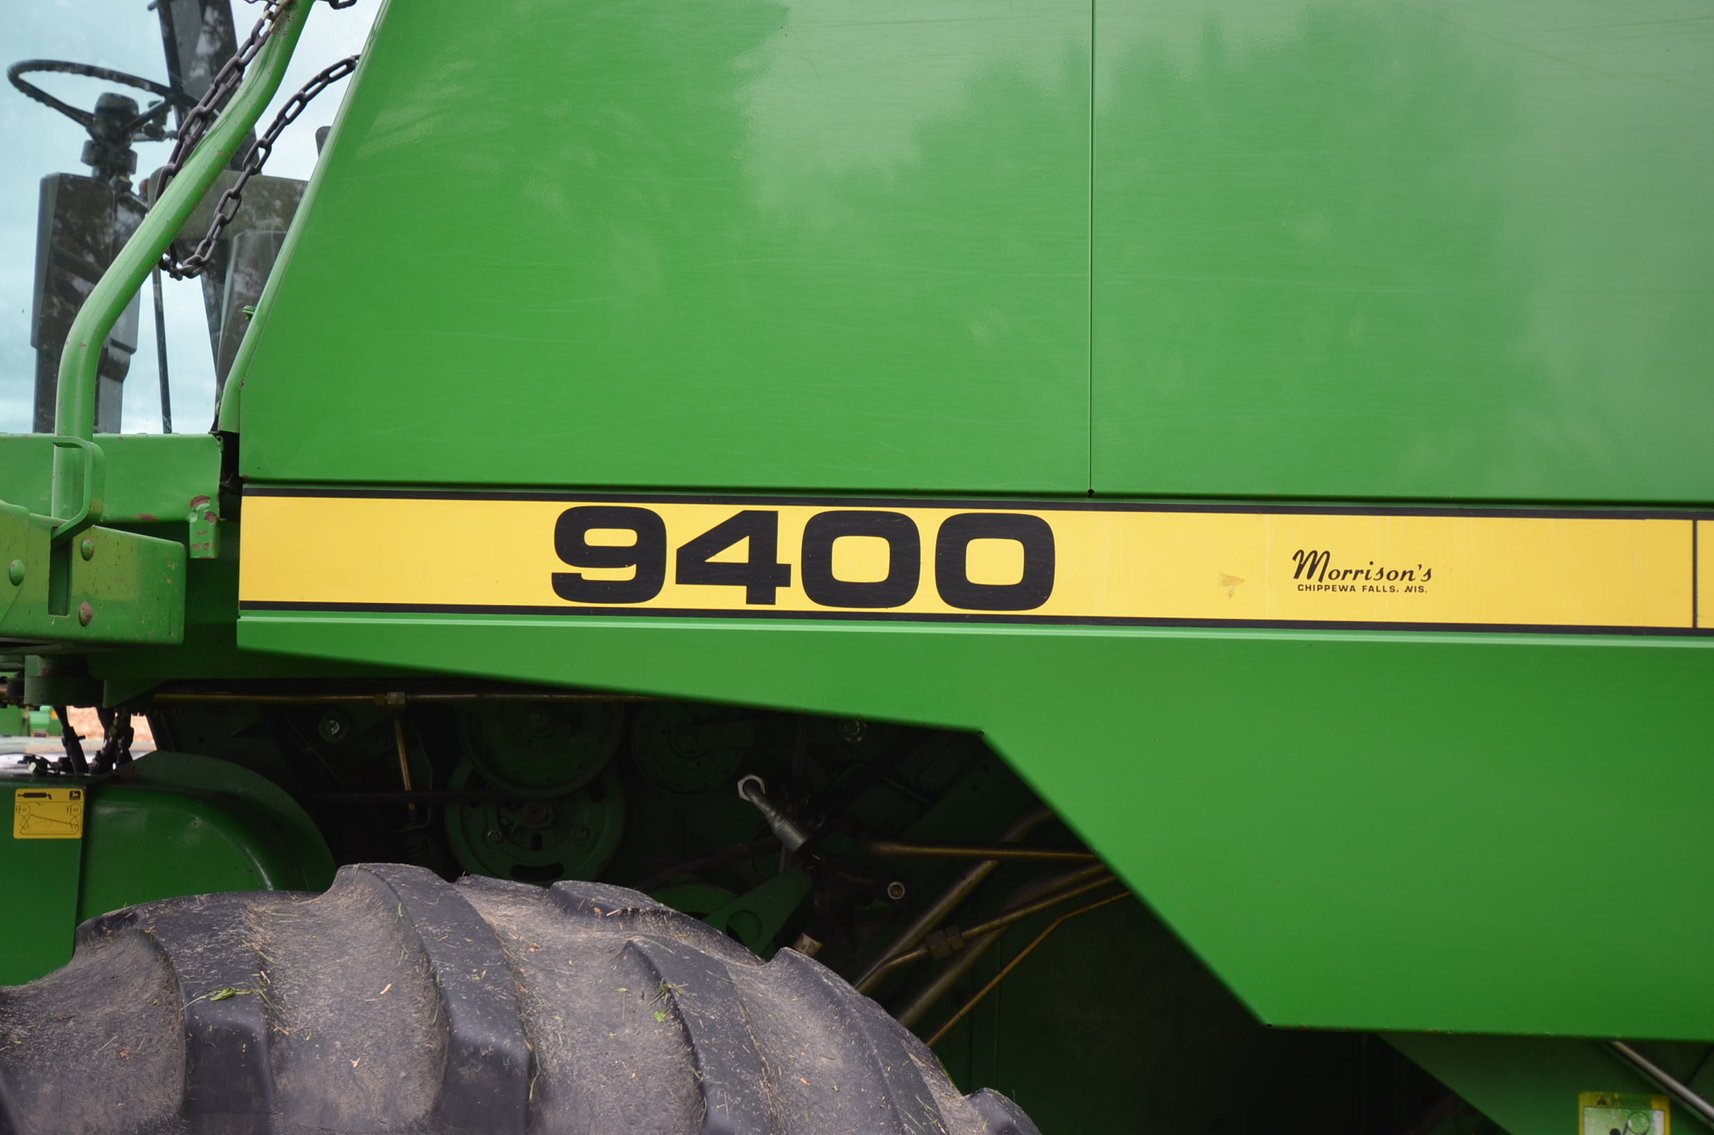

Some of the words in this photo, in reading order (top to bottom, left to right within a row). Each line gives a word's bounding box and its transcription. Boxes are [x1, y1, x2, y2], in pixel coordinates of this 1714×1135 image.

[551, 506, 1055, 610] 9400
[1292, 549, 1432, 582] Morrison's
[1297, 584, 1356, 592] CHIPPEWA
